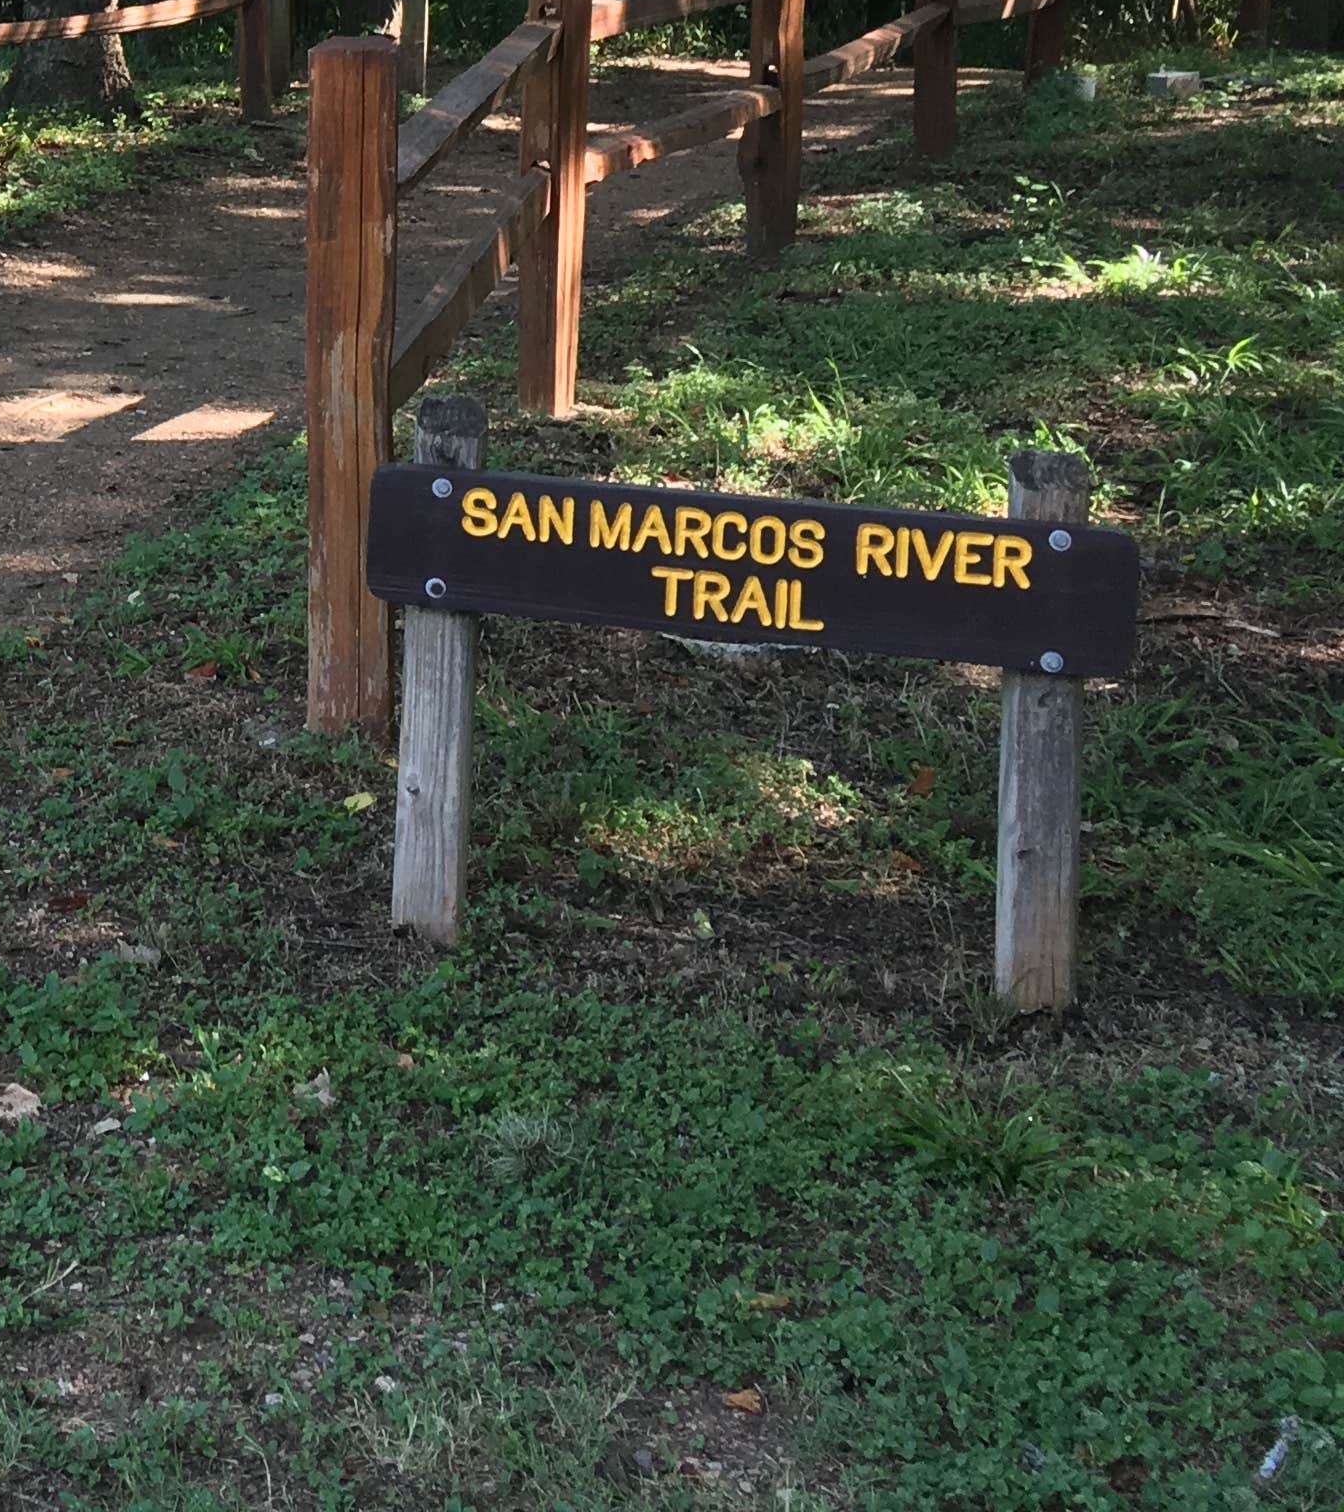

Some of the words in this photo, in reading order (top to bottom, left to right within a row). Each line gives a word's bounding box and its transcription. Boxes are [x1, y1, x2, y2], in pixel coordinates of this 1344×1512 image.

[461, 488, 575, 544] SAN
[589, 502, 825, 569] MARCOS
[856, 523, 1033, 590] RIVER
[651, 566, 825, 631] TRAIL
